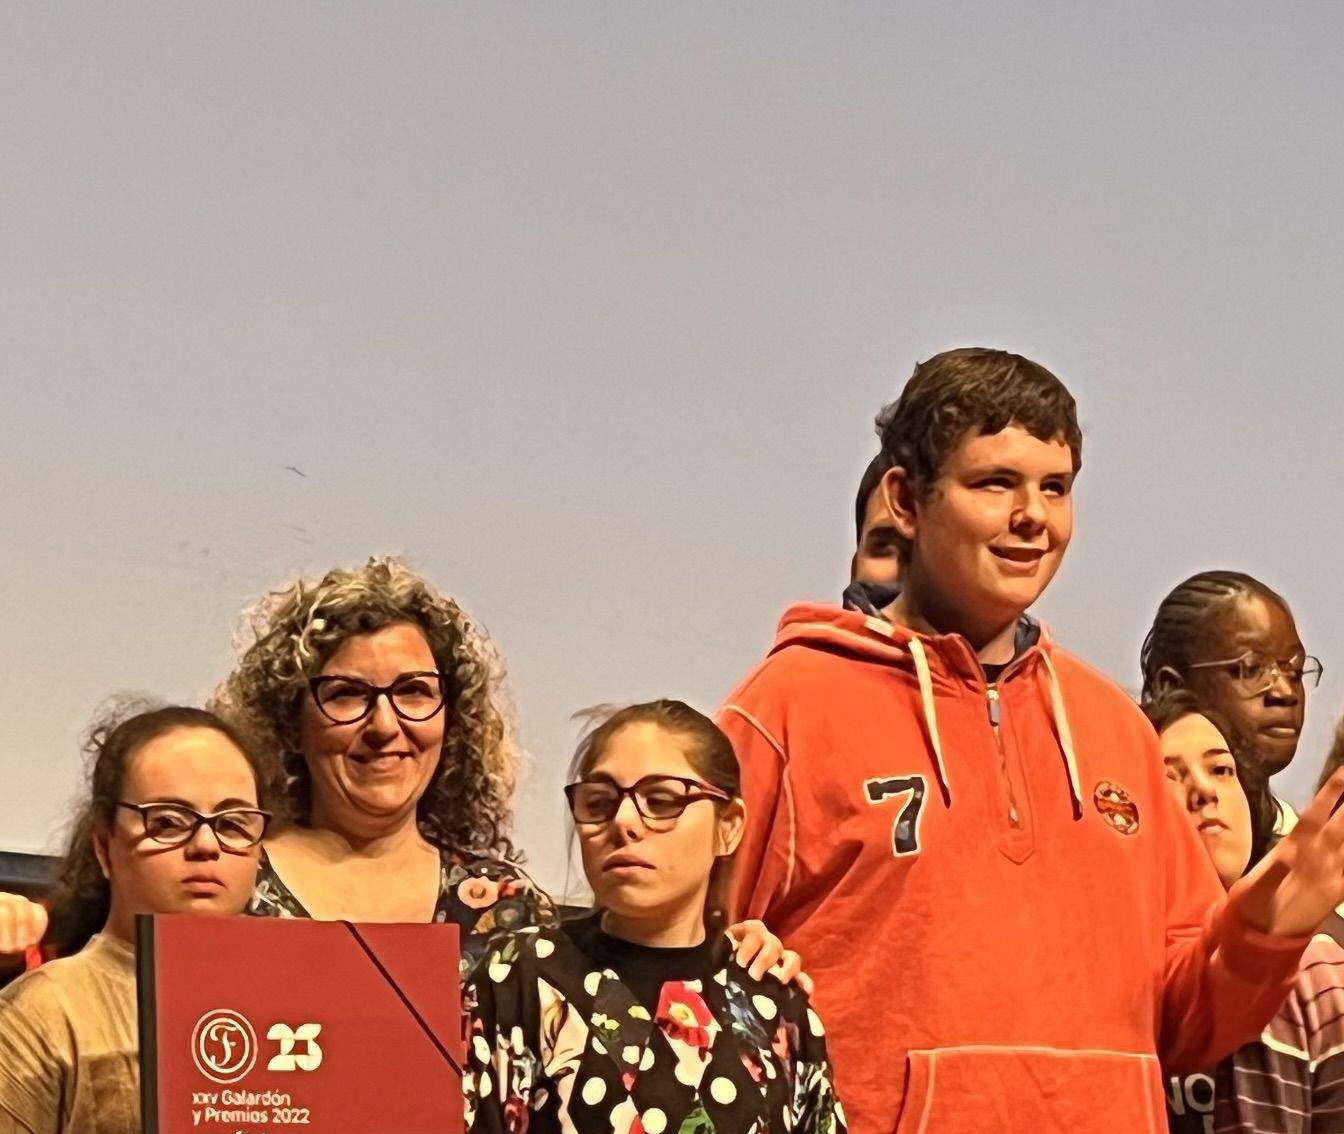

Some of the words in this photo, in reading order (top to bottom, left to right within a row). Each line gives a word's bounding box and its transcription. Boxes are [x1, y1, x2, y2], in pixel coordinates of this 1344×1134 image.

[863, 773, 928, 857] 7
[221, 1088, 291, 1106] Galardón
[191, 1109, 202, 1126] y
[206, 1106, 269, 1123] Premios
[272, 1108, 311, 1124] 2022
